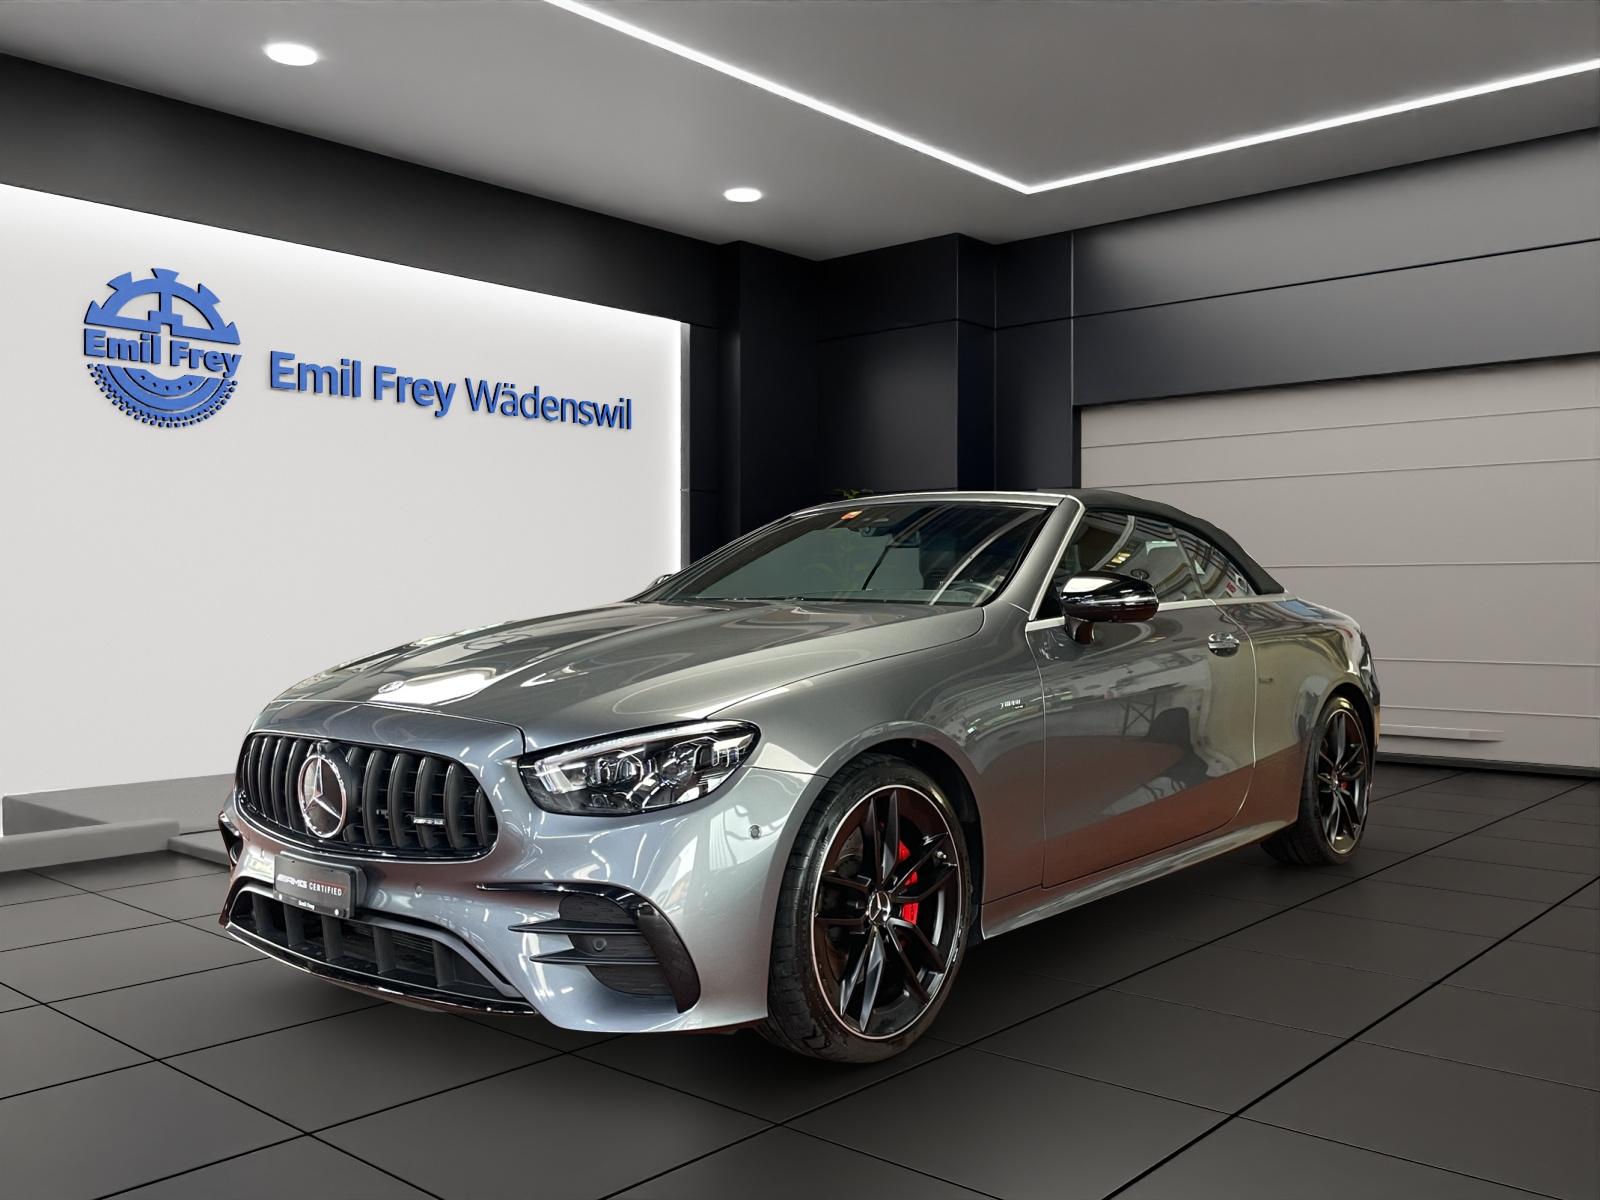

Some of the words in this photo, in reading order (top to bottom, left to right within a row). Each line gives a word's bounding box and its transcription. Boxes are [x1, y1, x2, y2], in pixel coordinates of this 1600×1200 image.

[84, 328, 161, 364] Emil
[169, 340, 242, 378] Frey
[270, 350, 361, 398] Emil
[373, 365, 456, 417] Frey
[464, 377, 632, 430] Wädenswil
[308, 881, 343, 897] CERTIFIED
